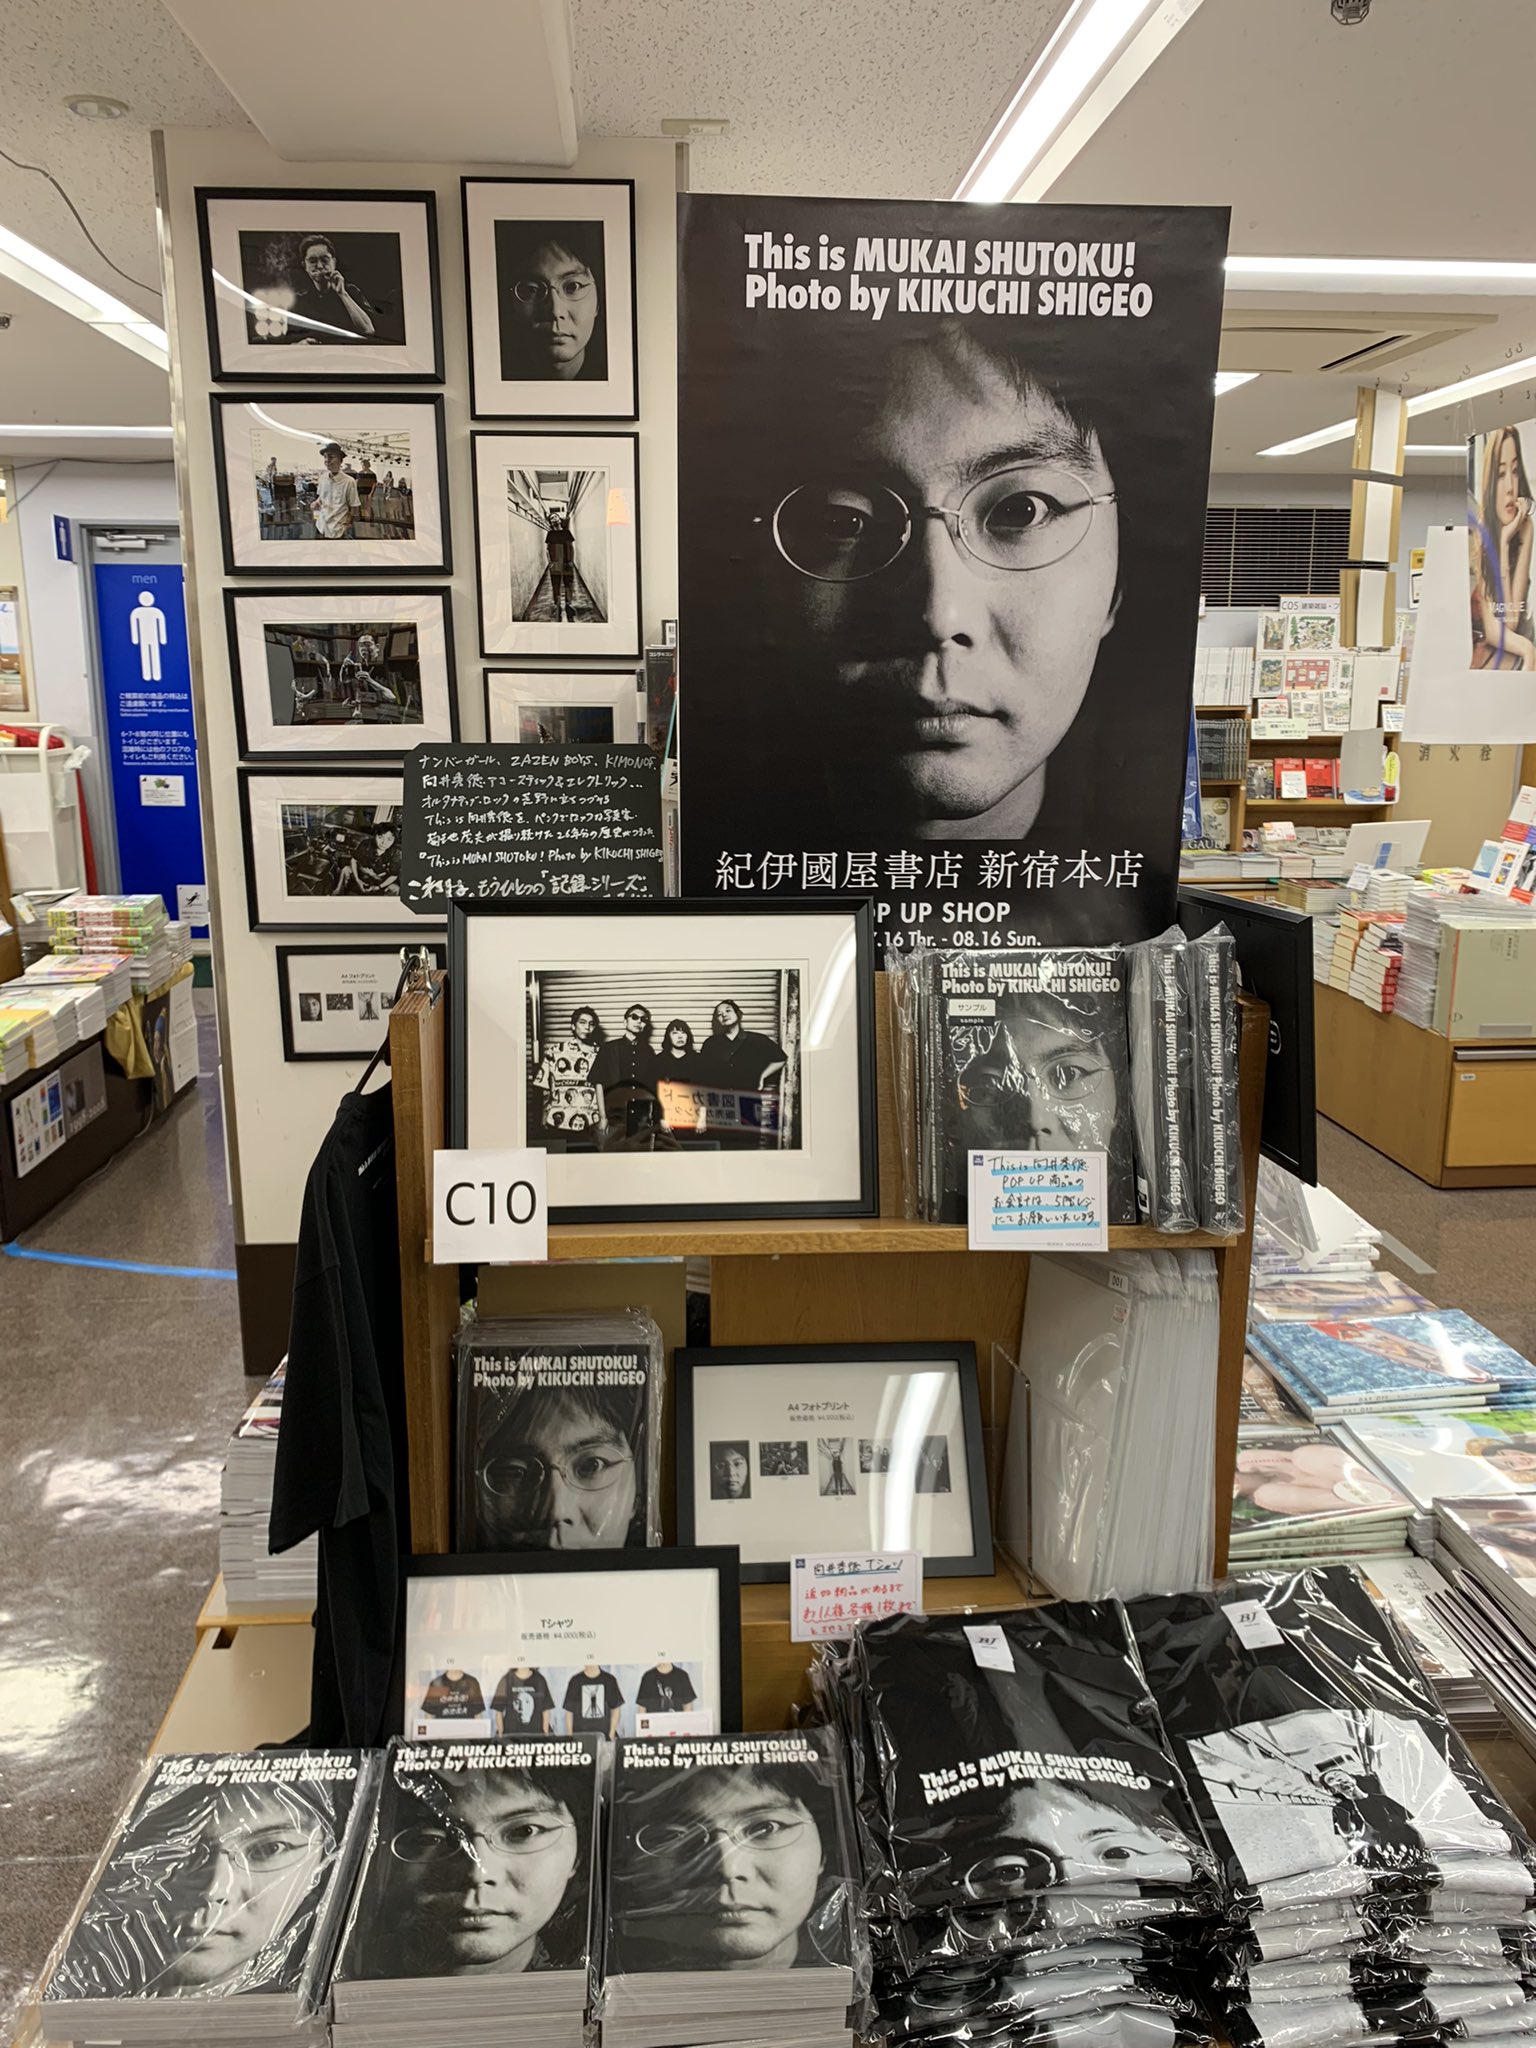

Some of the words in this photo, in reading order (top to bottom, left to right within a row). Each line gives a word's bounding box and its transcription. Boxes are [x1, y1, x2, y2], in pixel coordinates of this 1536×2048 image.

[744, 232, 811, 271] This
[818, 234, 845, 271] is
[853, 238, 966, 274] MUKAI
[974, 240, 1136, 278] SHUTOKU!
[745, 272, 841, 310] Photo
[850, 274, 890, 321] by
[898, 278, 1030, 315] KIKUCHI
[1038, 281, 1152, 318] SHIGEO
[132, 575, 158, 584] men
[511, 754, 560, 767] ZAZEN
[424, 812, 451, 826] This
[455, 815, 464, 824] is
[548, 848, 576, 861] Photo
[580, 847, 592, 863] by
[715, 850, 965, 890] 紀伊國屋書店
[977, 850, 1145, 890] 新宿本店
[901, 902, 933, 924] UP
[942, 902, 1011, 924] SHOP
[908, 931, 937, 947] Thr.
[953, 930, 1001, 947] 08.16
[1006, 930, 1041, 947] Sun.
[942, 962, 971, 978] This
[974, 963, 986, 978] is
[989, 963, 1038, 978] MUKAI
[1040, 962, 1111, 978] HUTOKU!
[942, 980, 984, 994] Photo
[988, 979, 1004, 997] by
[1069, 978, 1121, 993] SHIGEO
[958, 1004, 987, 1012] サンプル
[988, 1156, 1016, 1171] This
[1019, 1162, 1028, 1171] is
[1002, 1174, 1024, 1190] POP
[1029, 1174, 1044, 1185] UP
[445, 1180, 537, 1226] C10
[474, 1356, 502, 1372] This
[504, 1356, 517, 1371] is
[519, 1355, 567, 1370] MUKAI
[570, 1355, 638, 1370] SHUTOKU!
[474, 1372, 515, 1387] Photo
[518, 1371, 535, 1390] by
[538, 1371, 594, 1386] KIKUCHI
[597, 1370, 646, 1386] SHIGEO
[788, 1403, 799, 1411] A4
[801, 1401, 850, 1411] フォトプリント
[540, 1618, 574, 1628] Tシャツ
[396, 1748, 429, 1760] This
[432, 1746, 445, 1759] is
[448, 1744, 502, 1758] MUKAI
[505, 1742, 583, 1756] SHUTOKU!
[624, 1743, 655, 1756] This
[658, 1743, 672, 1755] is
[674, 1742, 728, 1754] MUKAI
[731, 1740, 808, 1753] SHUTOKU!
[161, 1758, 193, 1774] This
[196, 1758, 210, 1772] is
[214, 1758, 270, 1772] MUKAI
[272, 1756, 352, 1770] SHUTOKU!
[394, 1758, 442, 1772] Photo
[444, 1757, 464, 1772] by
[467, 1755, 533, 1769] KIKUCHI
[535, 1754, 592, 1767] SHIGEO
[623, 1756, 670, 1768] Photo
[672, 1754, 694, 1770] by
[696, 1752, 760, 1766] KIKUCHI
[763, 1750, 819, 1764] SHIGEO
[154, 1773, 203, 1786] Photo
[206, 1771, 228, 1787] by
[229, 1770, 299, 1784] KIKUCHI
[299, 1768, 358, 1782] SHIGEO
[920, 1768, 958, 1789] This
[958, 1762, 977, 1777] is
[979, 1750, 1044, 1772] MUKAI
[1044, 1753, 1134, 1776] SHUTOKU!
[924, 1776, 979, 1805] Photo
[980, 1772, 1006, 1788] by
[1008, 1764, 1086, 1782] KIKUCHI
[1088, 1769, 1151, 1791] SHIGEO
